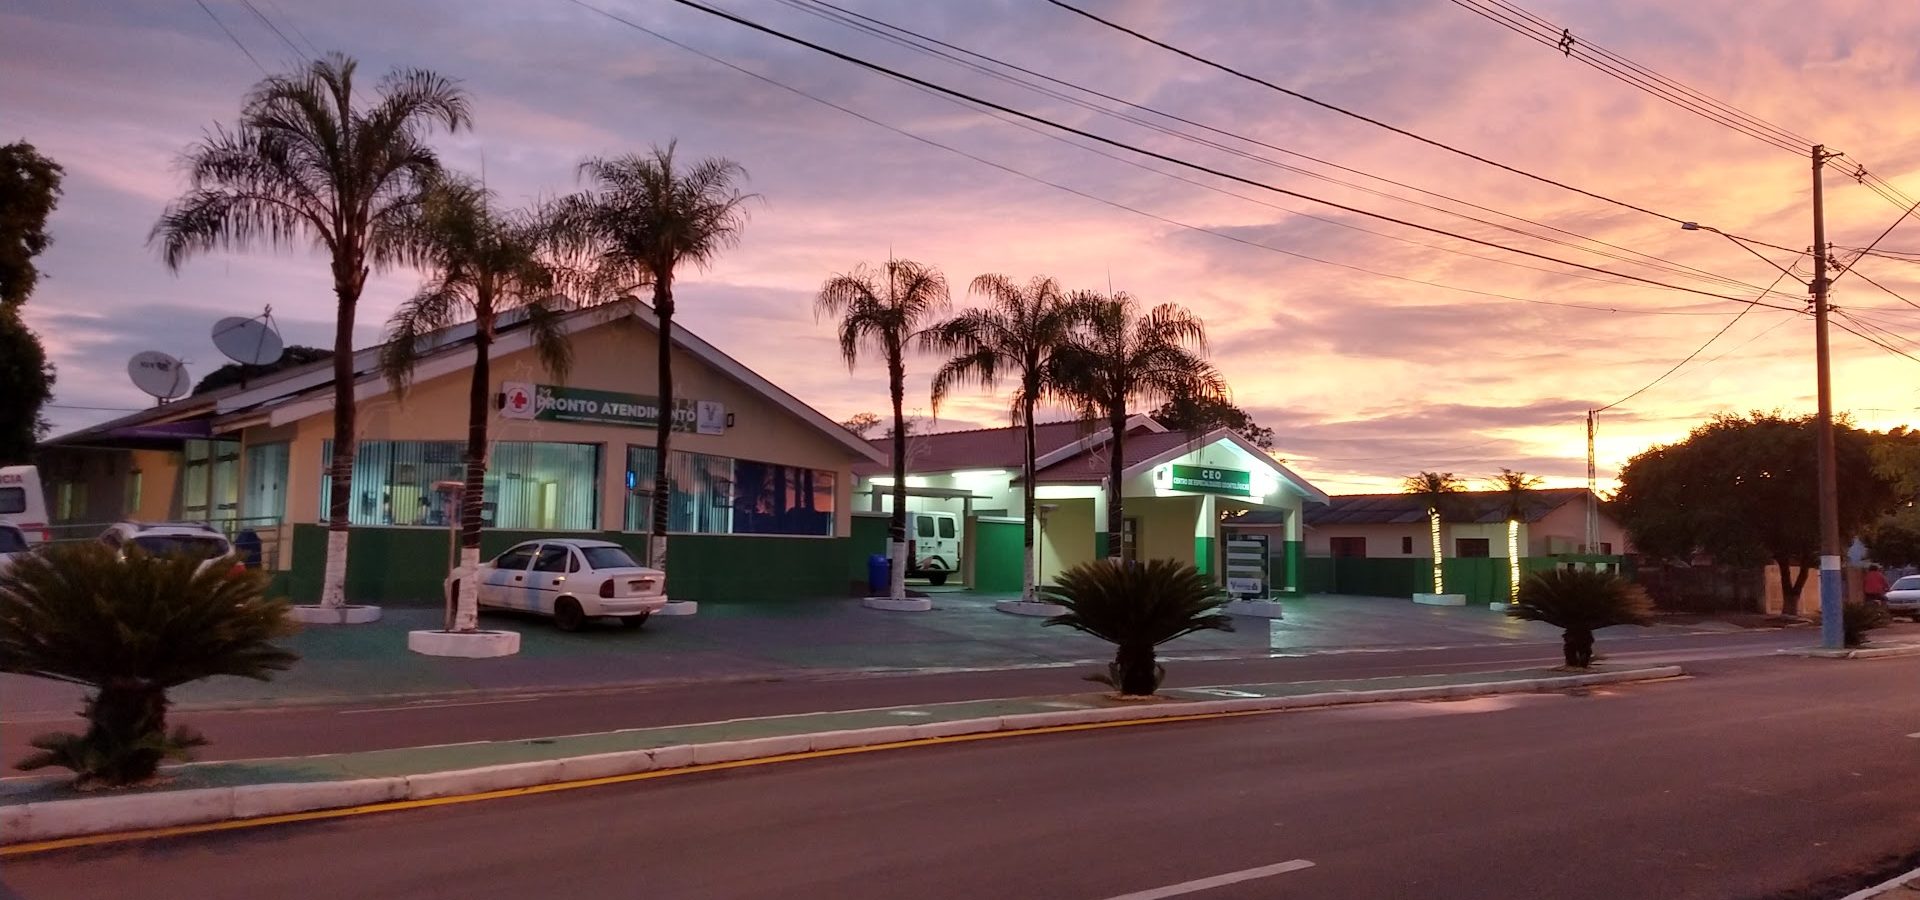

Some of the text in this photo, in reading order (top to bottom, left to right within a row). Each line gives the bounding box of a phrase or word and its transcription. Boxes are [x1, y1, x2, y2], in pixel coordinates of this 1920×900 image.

[536, 395, 598, 413] PRONTO
[601, 403, 696, 422] ATENDIMNTO
[0, 475, 23, 484] CIA
[1202, 470, 1221, 480] CEO
